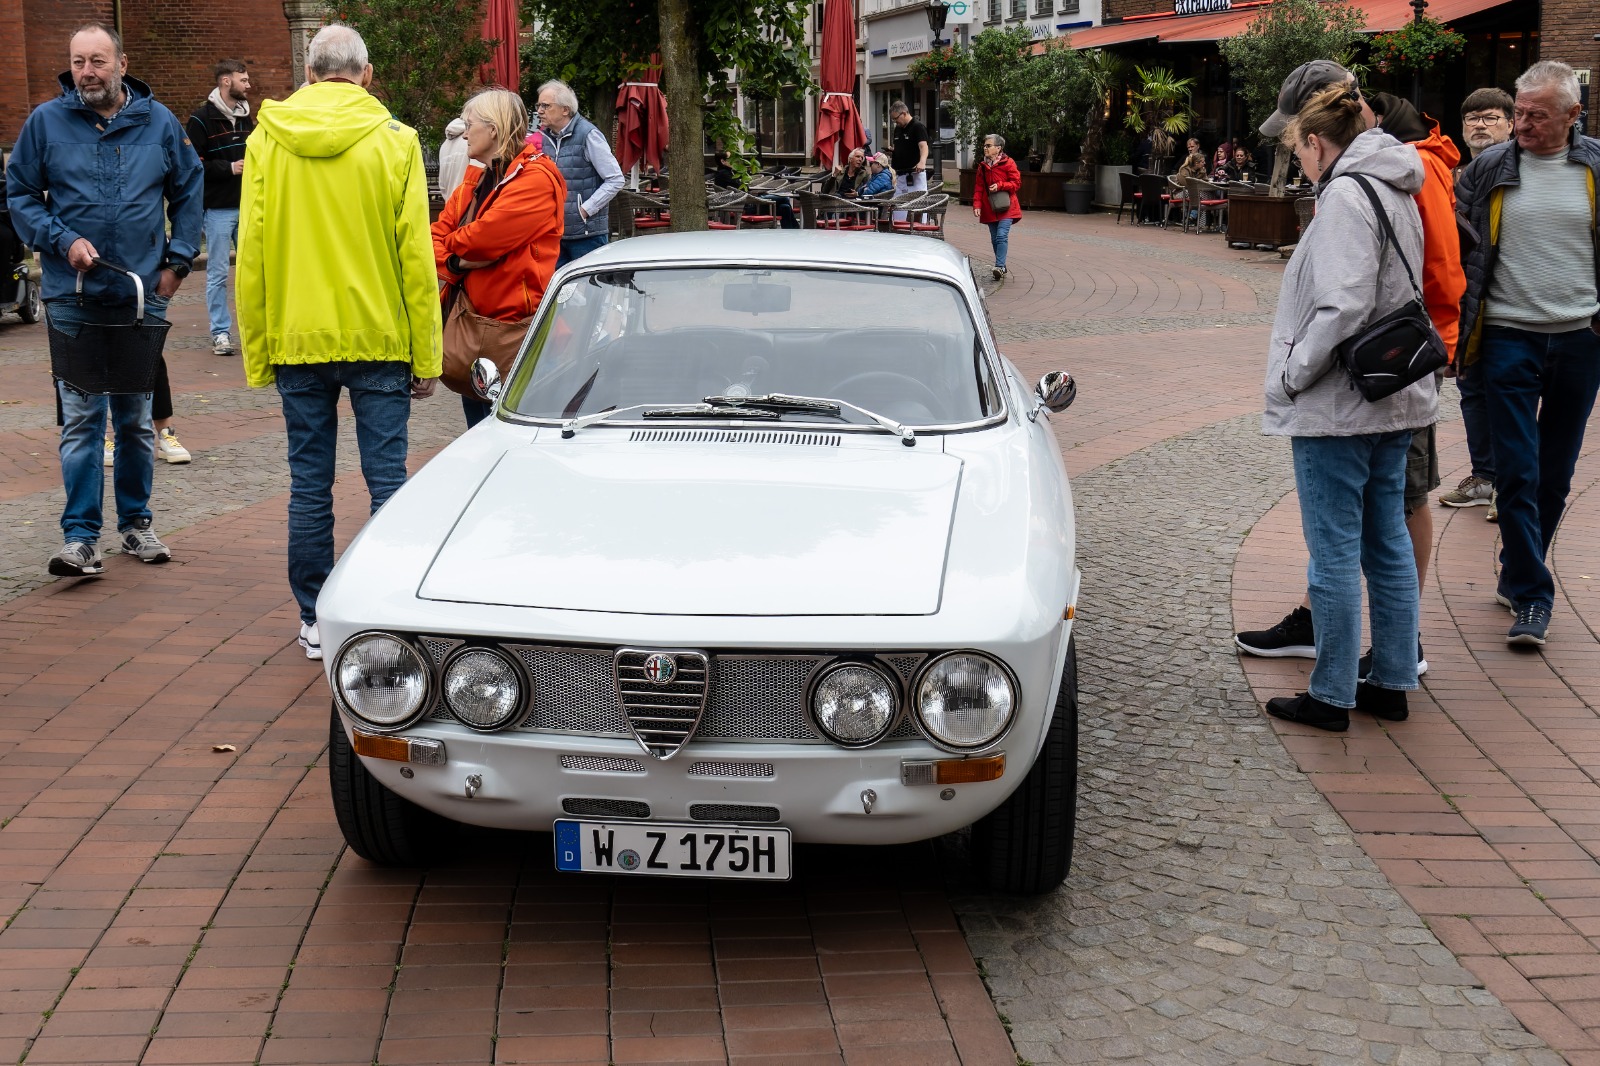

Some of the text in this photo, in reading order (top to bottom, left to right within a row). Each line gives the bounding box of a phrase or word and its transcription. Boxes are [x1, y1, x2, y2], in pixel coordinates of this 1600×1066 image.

[564, 851, 574, 862] D
[593, 829, 615, 867] W
[646, 831, 669, 869] Z
[679, 832, 776, 873] 175H
